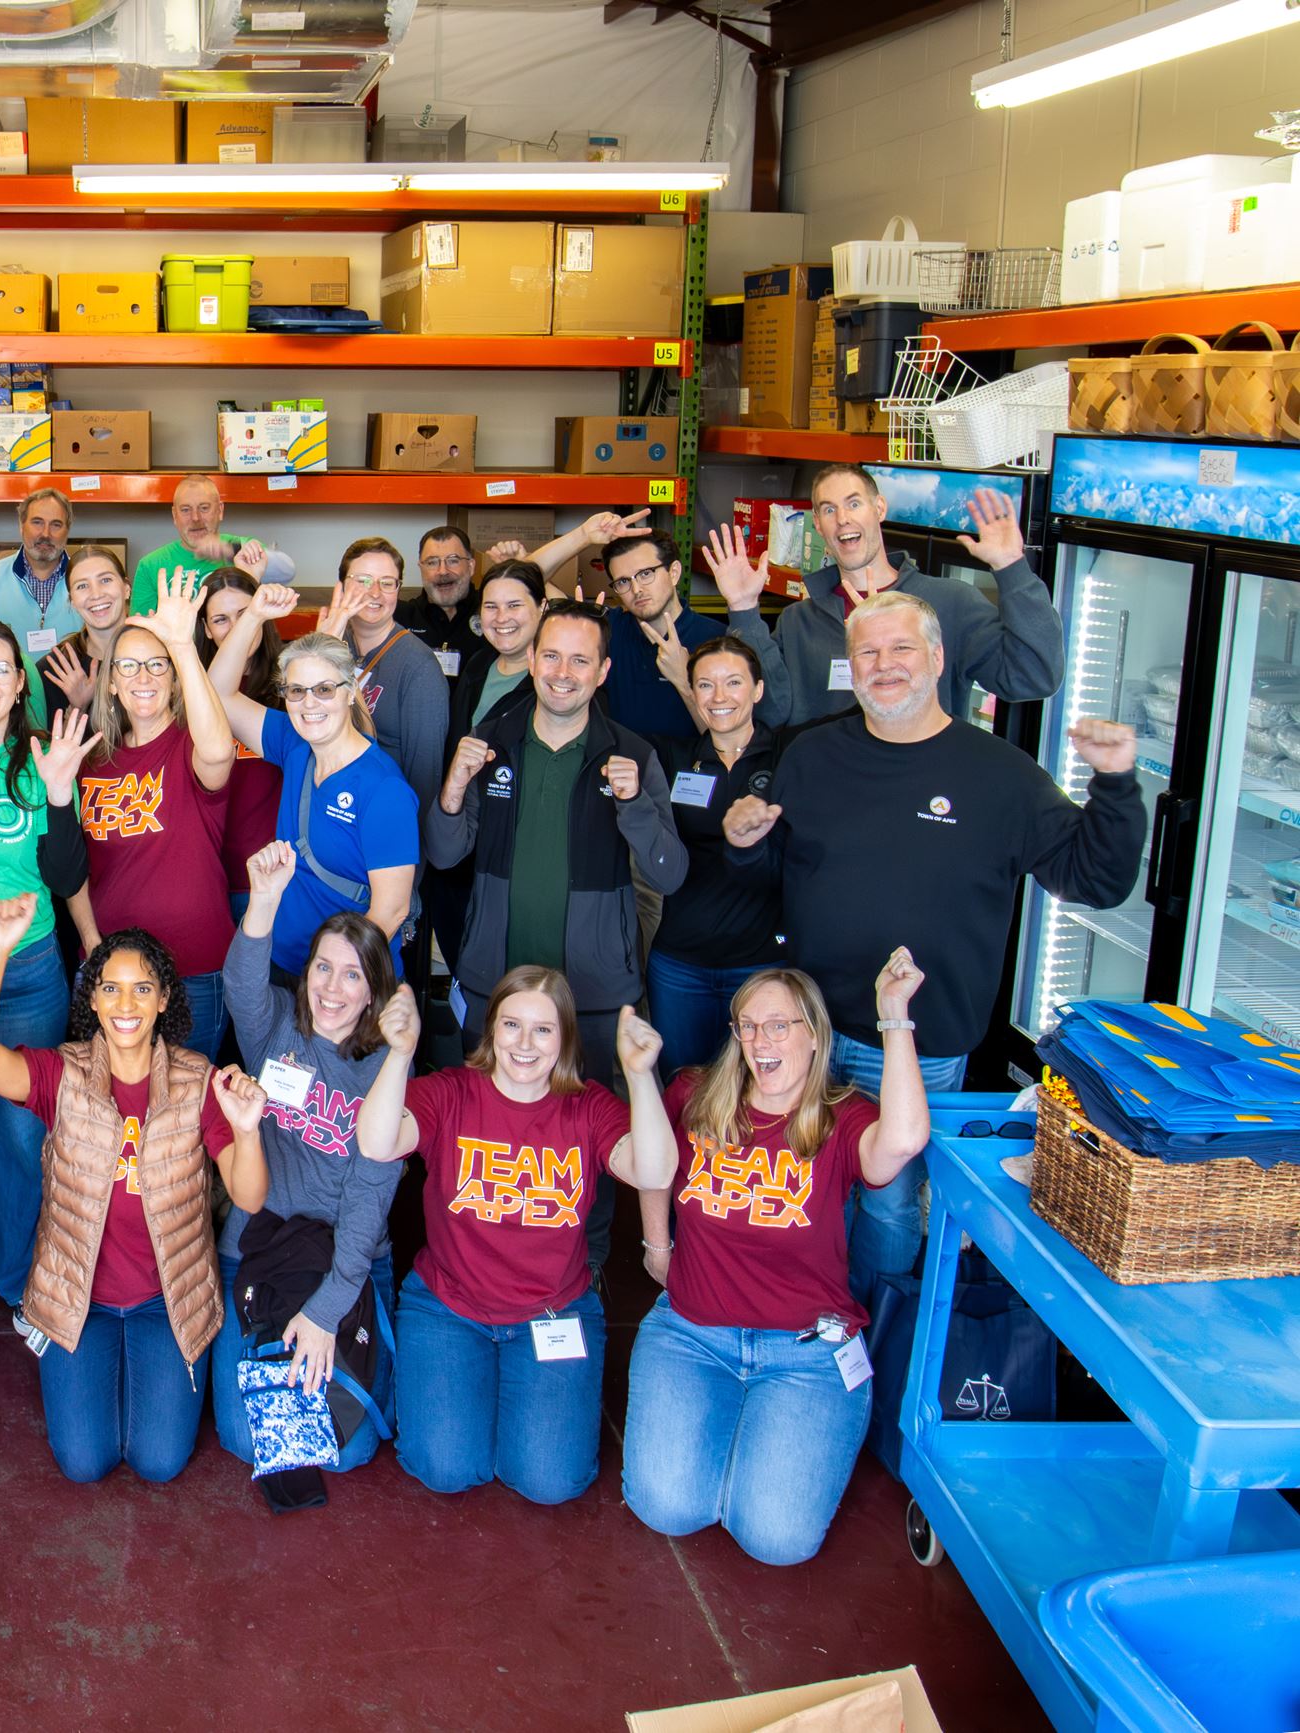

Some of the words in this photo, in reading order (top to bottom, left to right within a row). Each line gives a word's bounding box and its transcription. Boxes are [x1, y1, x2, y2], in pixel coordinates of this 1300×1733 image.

[661, 193, 680, 206] U6
[655, 348, 673, 360] U5
[239, 454, 263, 462] change
[650, 485, 668, 497] U4
[81, 765, 165, 818] TEAM
[82, 788, 164, 840] APEX
[916, 811, 934, 821] TOWN
[457, 1136, 582, 1190] TEAM
[687, 1130, 812, 1188] TEAM
[448, 1178, 583, 1228] APEX
[678, 1170, 812, 1228] APEX
